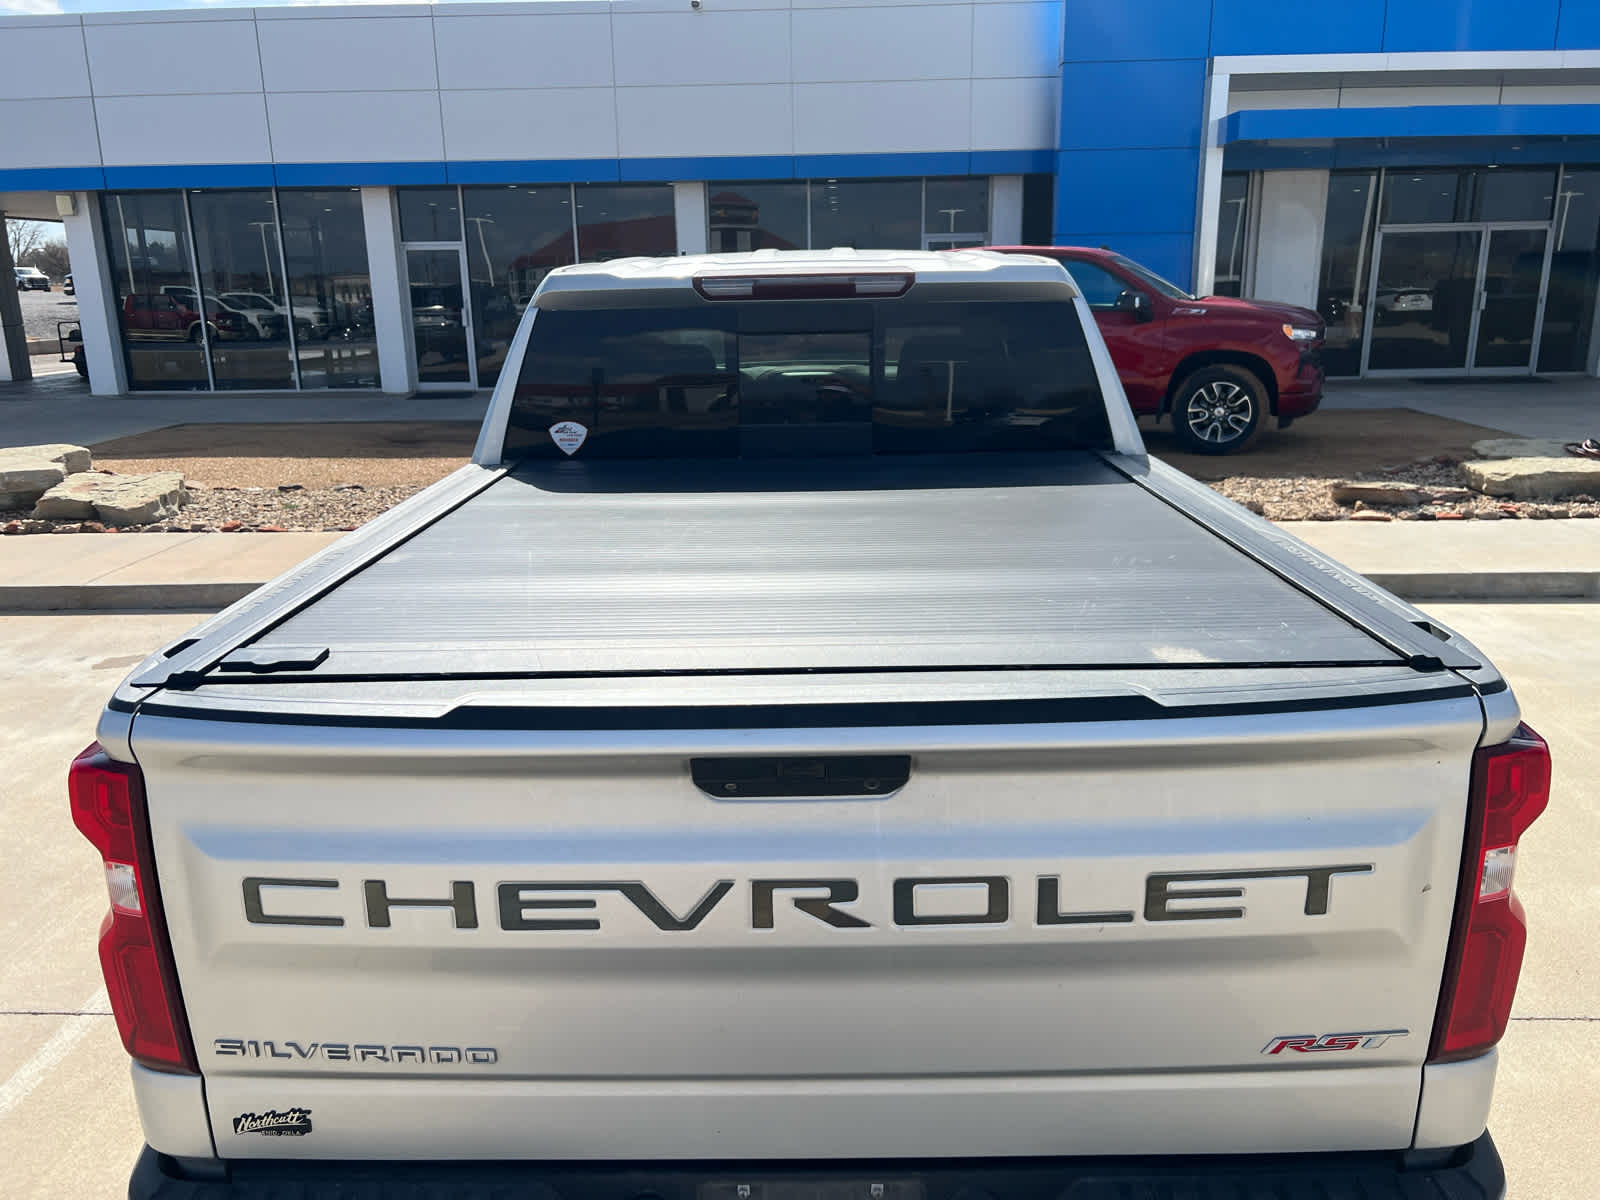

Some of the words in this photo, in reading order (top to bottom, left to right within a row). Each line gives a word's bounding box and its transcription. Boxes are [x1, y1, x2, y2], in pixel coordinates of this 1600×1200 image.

[242, 863, 1375, 931] CHEVROLET
[213, 1038, 499, 1065] SILVERADO
[1260, 1029, 1409, 1055] RST
[237, 1111, 305, 1133] Northcutt
